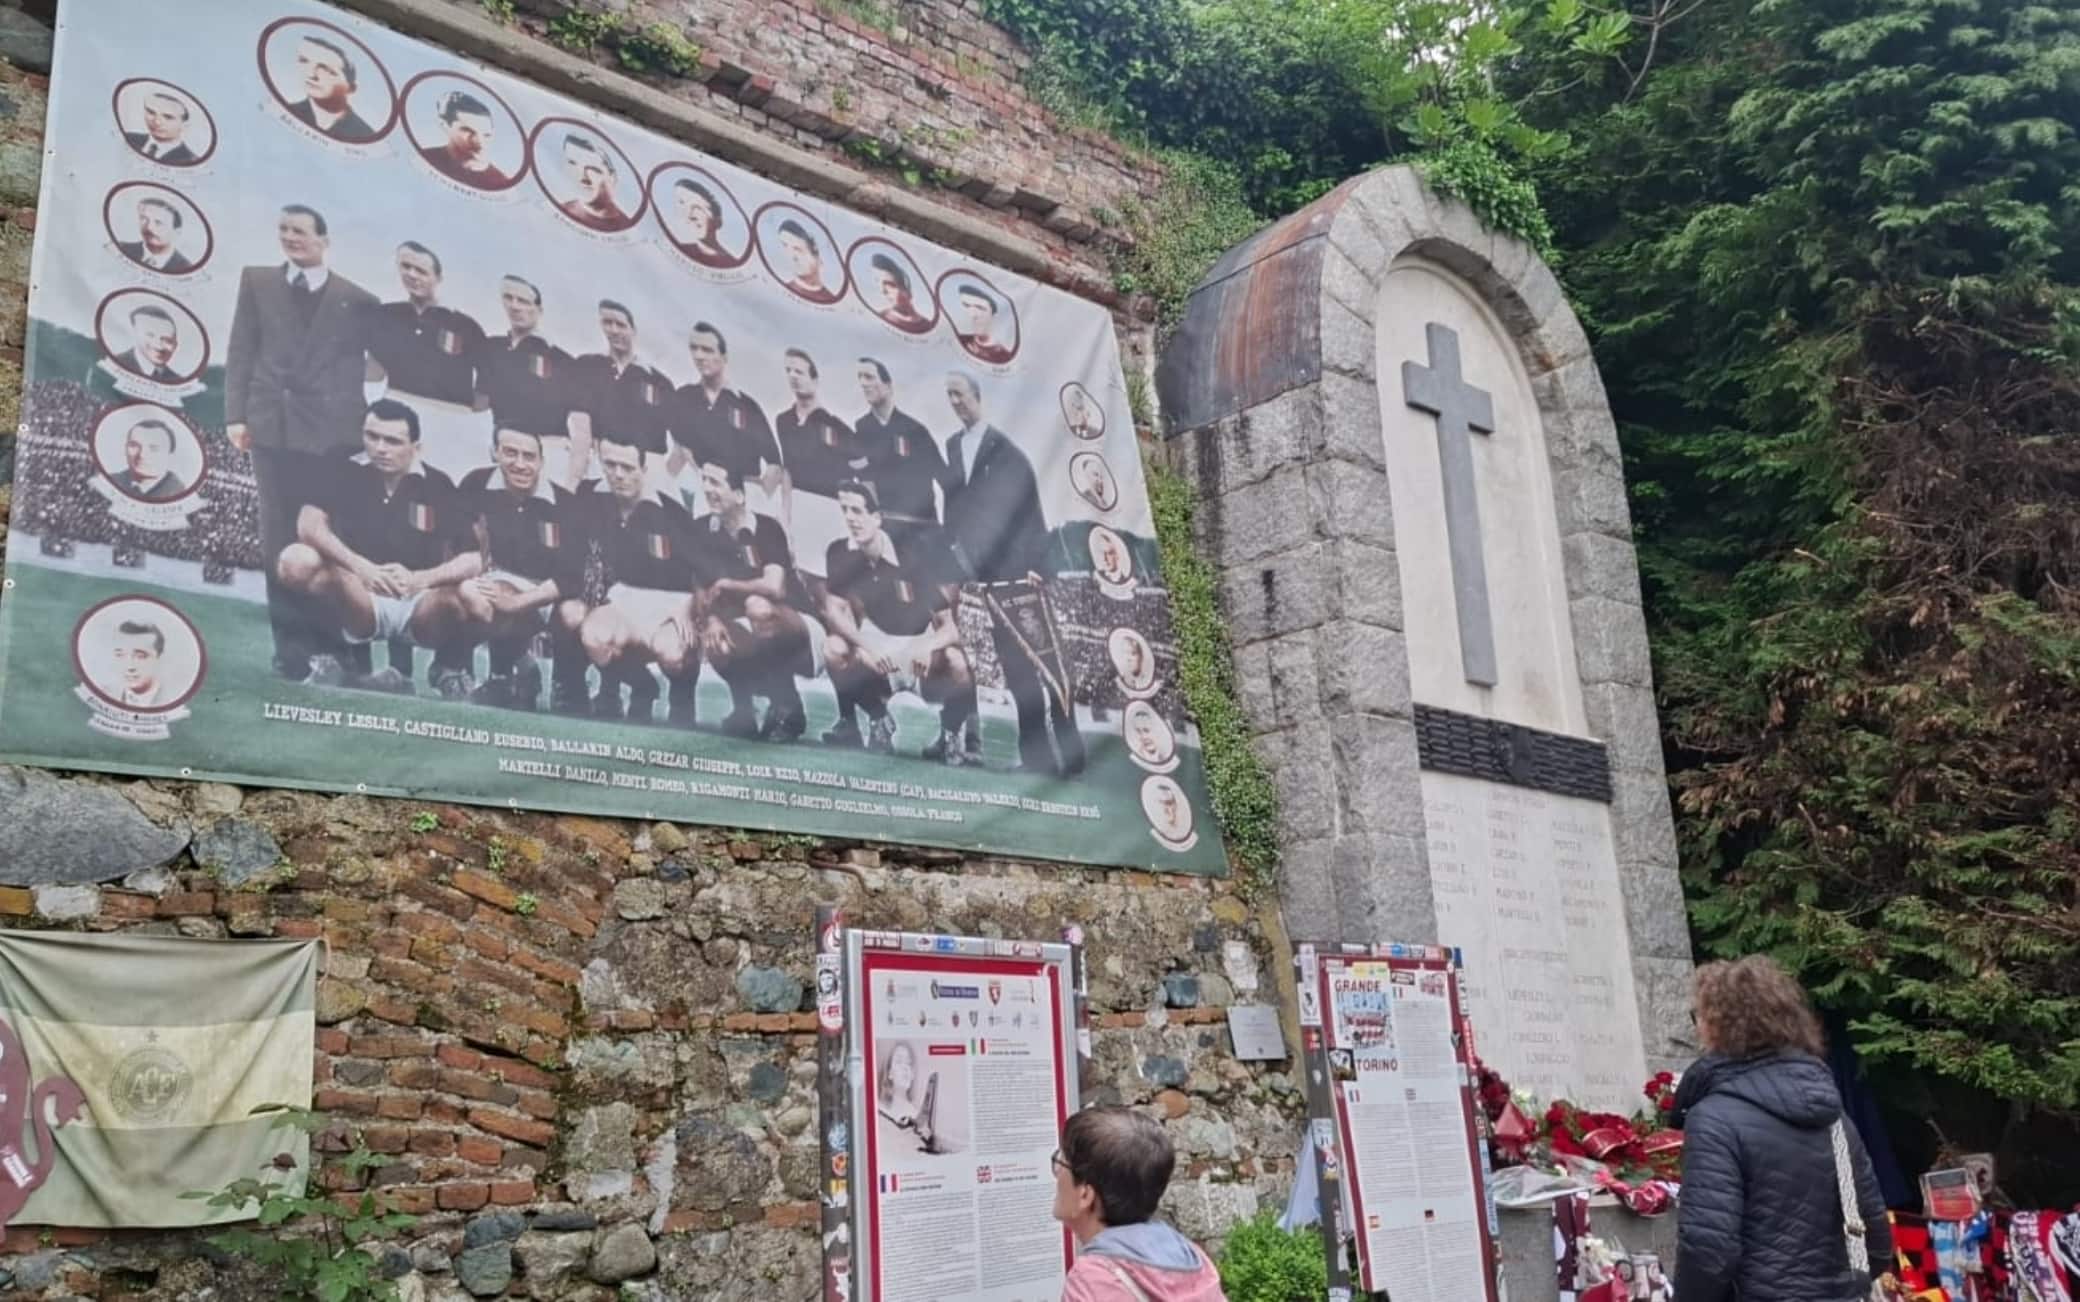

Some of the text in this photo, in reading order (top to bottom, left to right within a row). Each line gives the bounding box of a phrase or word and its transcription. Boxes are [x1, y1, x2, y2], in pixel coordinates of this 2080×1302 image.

[264, 703, 342, 726] LIEVESLEY
[348, 713, 400, 735] LESLIE,
[404, 720, 489, 745] CASTIGLIANO
[498, 759, 561, 778] MARTELLI
[1335, 978, 1382, 992] GRANDE
[1356, 1057, 1398, 1072] TORINO
